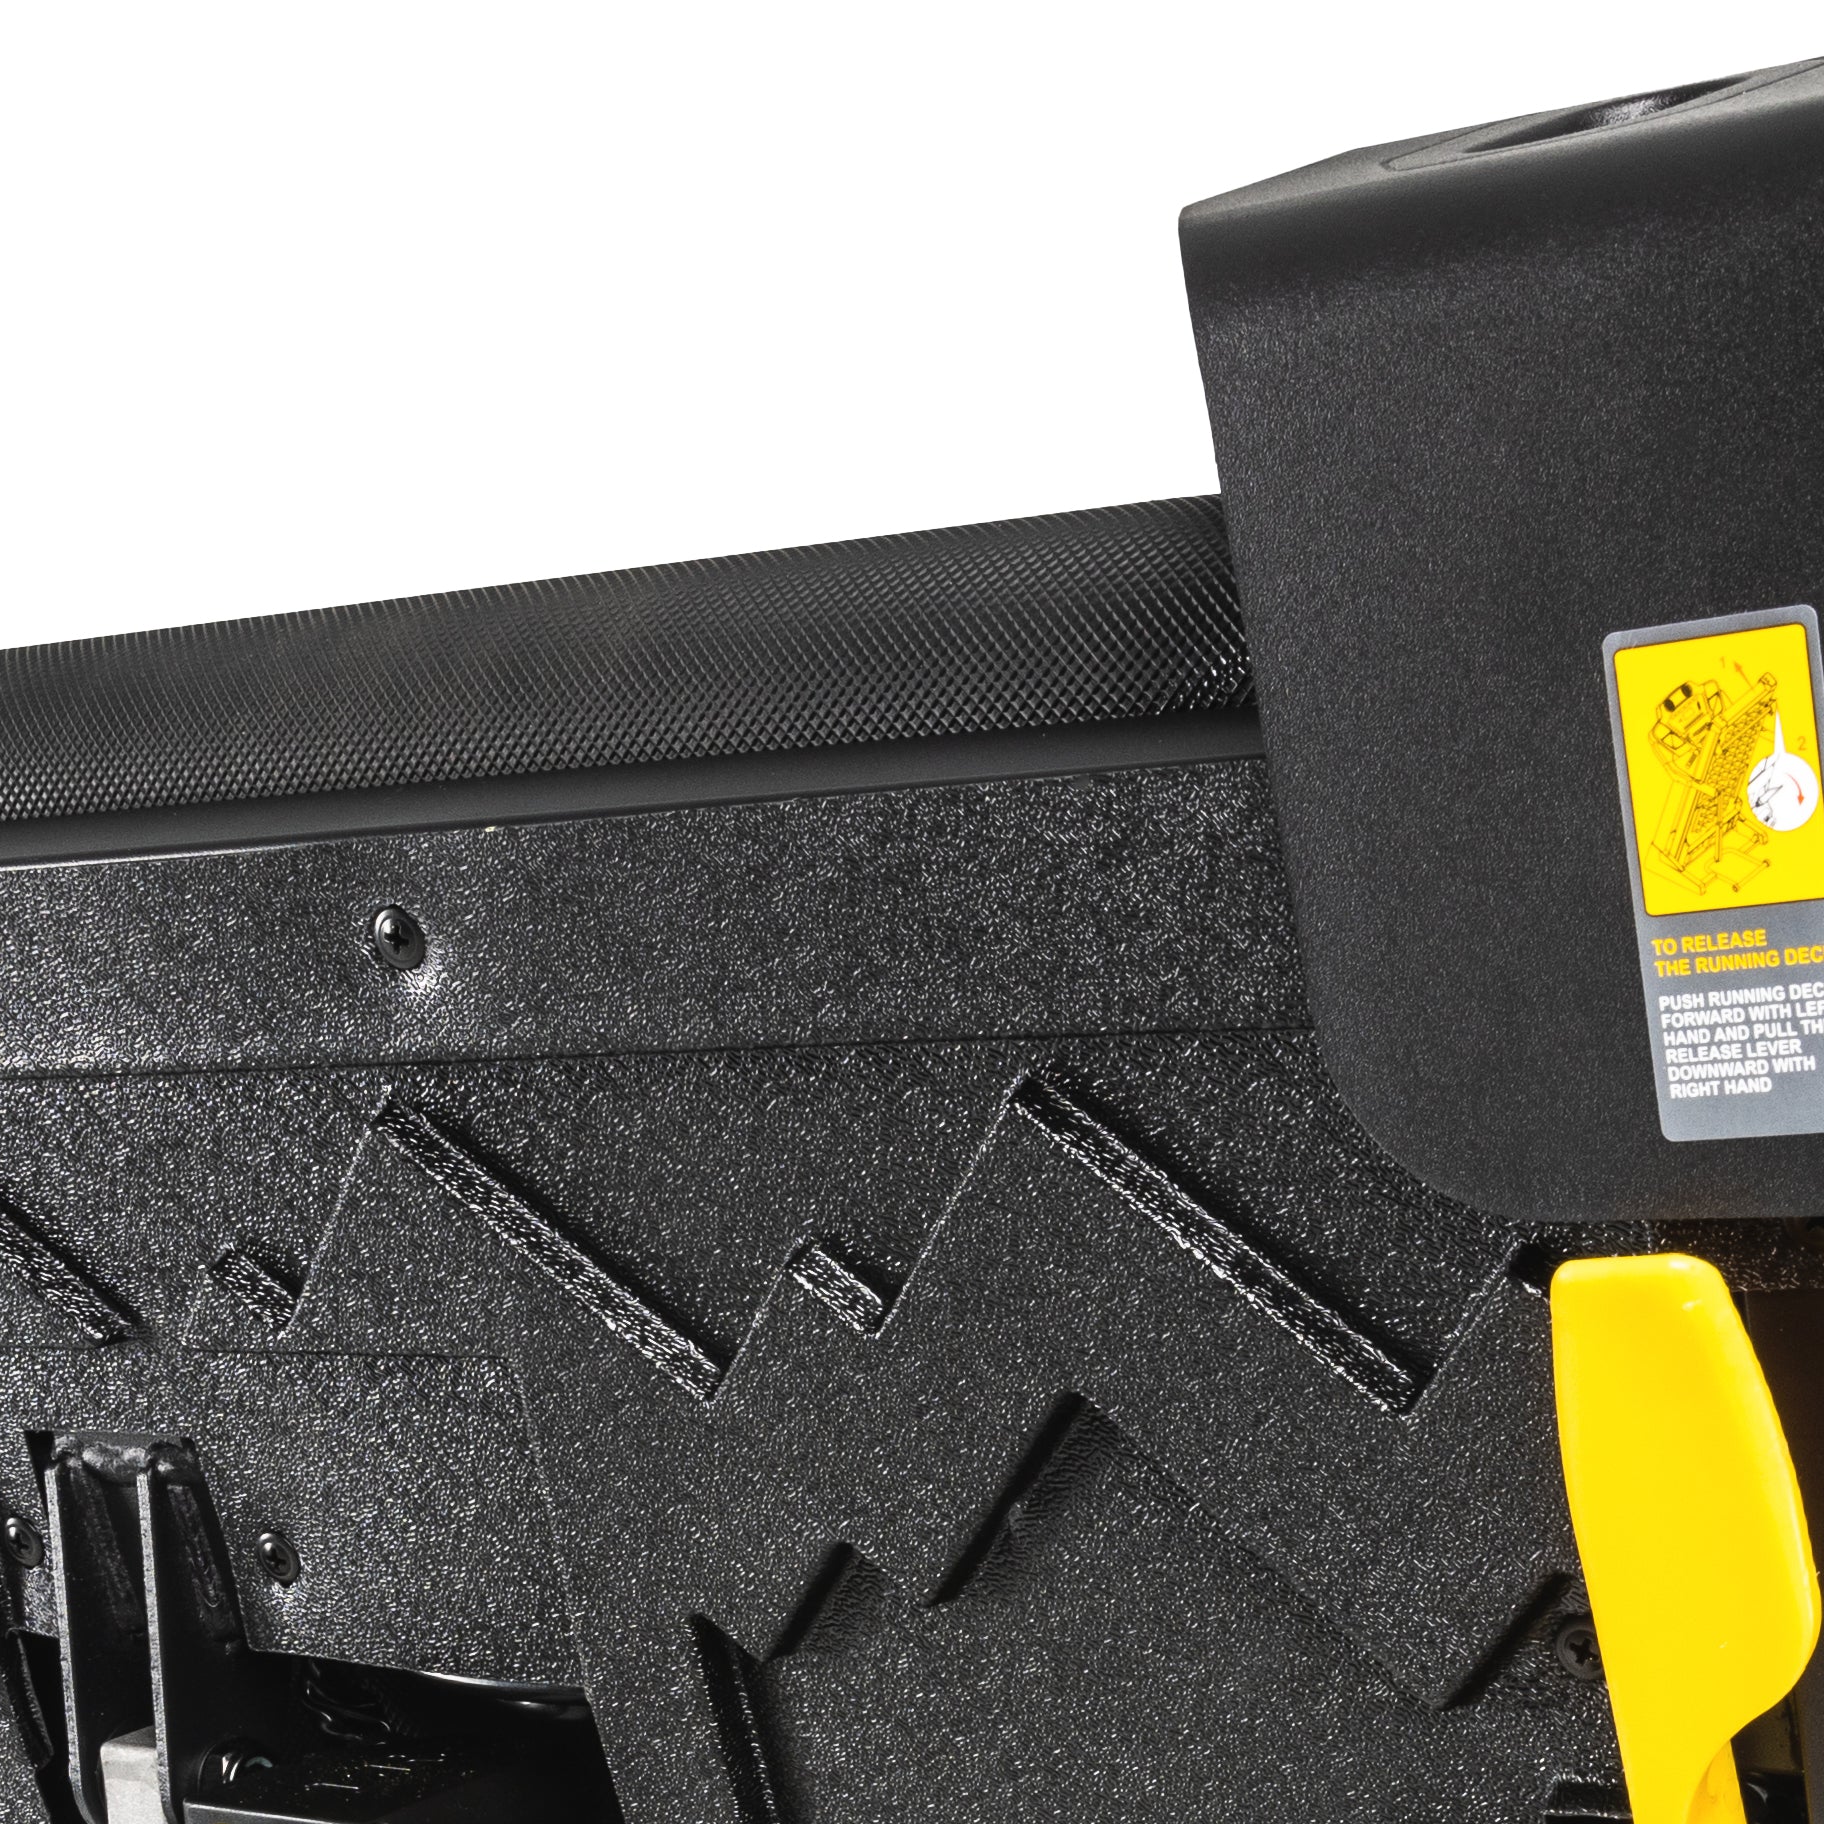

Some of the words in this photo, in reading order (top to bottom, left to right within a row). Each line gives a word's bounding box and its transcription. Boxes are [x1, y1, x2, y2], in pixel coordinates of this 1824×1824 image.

[1796, 735, 1807, 751] 2
[1651, 937, 1678, 956] TO
[1681, 928, 1768, 954] RELEASE
[1654, 958, 1692, 978] THE
[1695, 949, 1781, 974] RUNNING
[1658, 992, 1705, 1011] PUSH
[1708, 986, 1786, 1007] RUNNING
[1661, 1007, 1746, 1029] FORWARD
[1748, 1003, 1792, 1022] WITH
[1663, 1028, 1710, 1047] HAND
[1714, 1025, 1750, 1043] AND
[1753, 1021, 1798, 1040] PULL
[1665, 1043, 1743, 1064] RELEASE
[1746, 1038, 1803, 1058] LEVER
[1667, 1058, 1769, 1082] DOWNWARD
[1772, 1055, 1816, 1074] WITH
[1669, 1080, 1721, 1100] RIGHT
[1724, 1076, 1773, 1095] HAND
